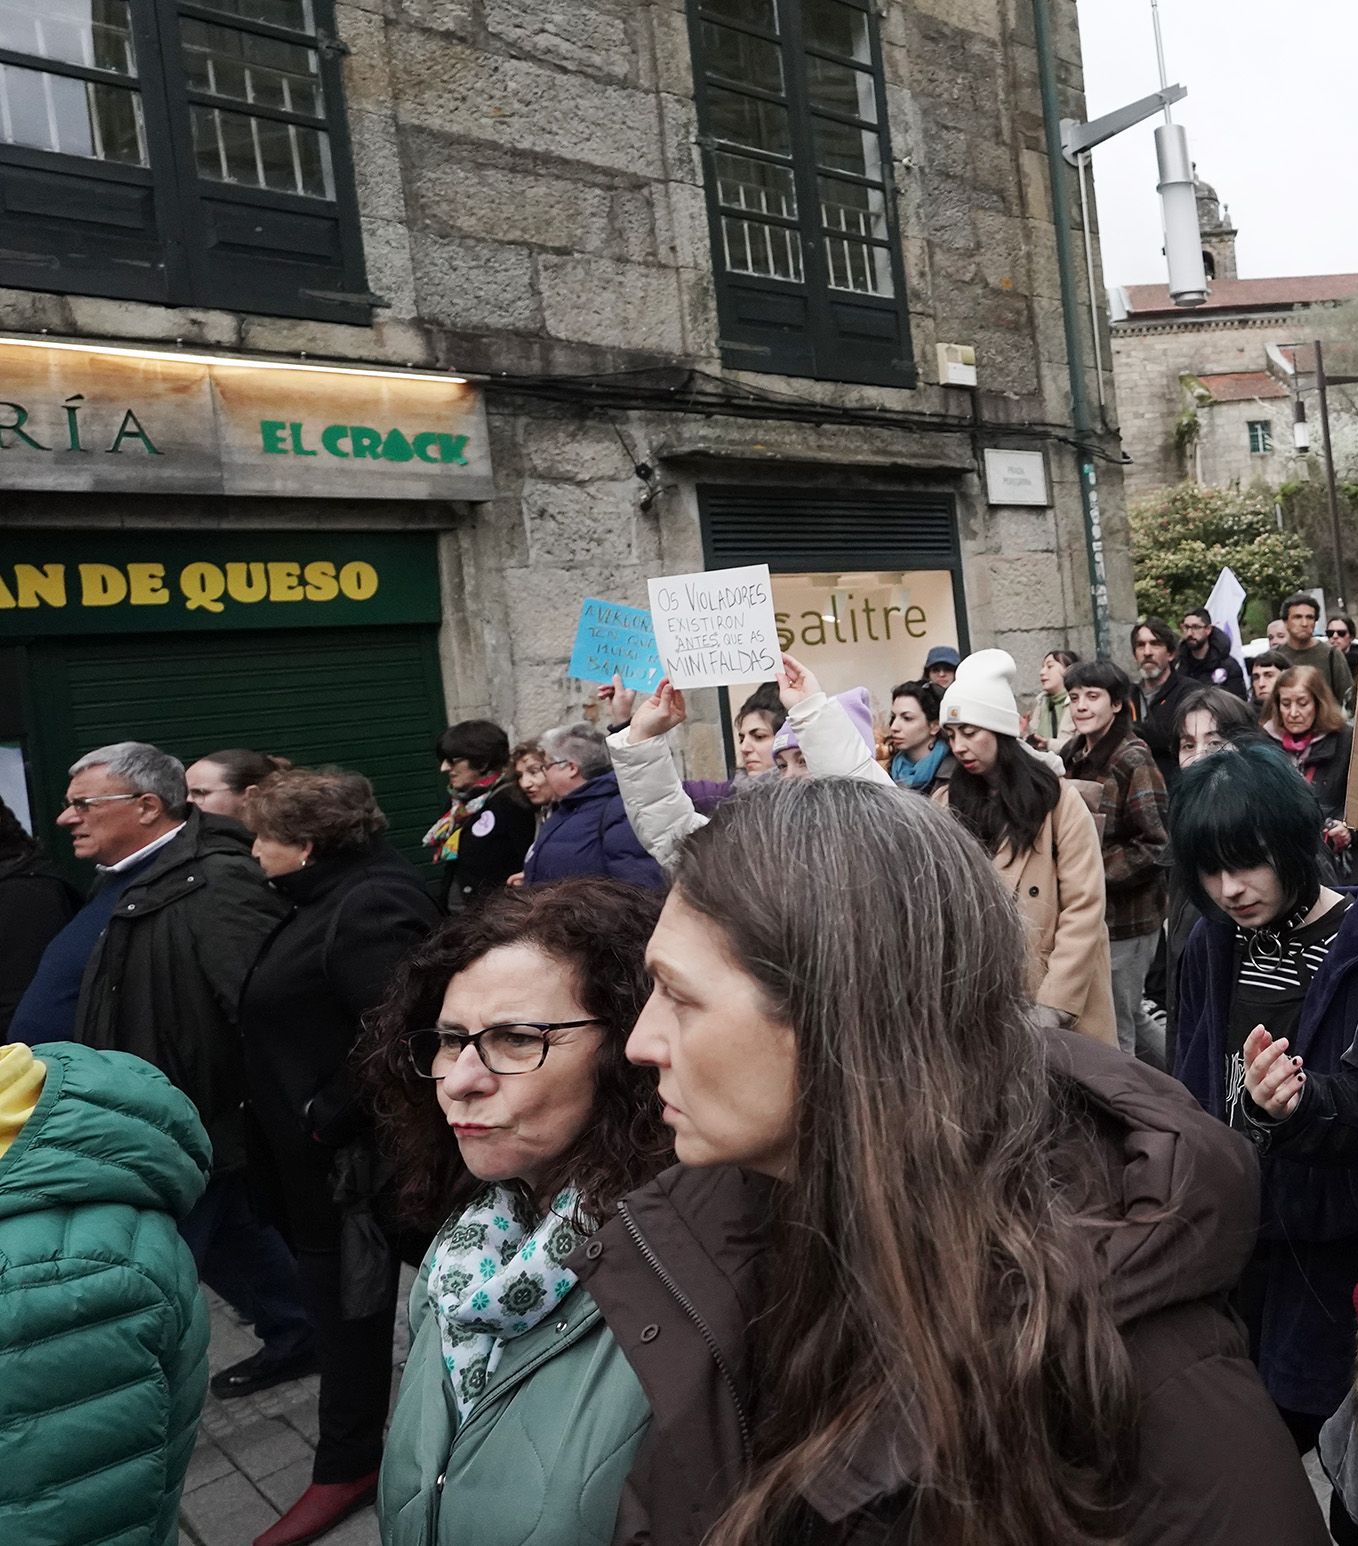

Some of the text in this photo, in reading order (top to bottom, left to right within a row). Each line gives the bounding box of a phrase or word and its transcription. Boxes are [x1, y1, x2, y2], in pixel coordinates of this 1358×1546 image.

[260, 420, 317, 456] EL
[78, 562, 170, 607] DE
[180, 560, 380, 613] QUESO
[685, 582, 767, 612] VIOLADORES
[668, 612, 745, 633] EXISTIRON
[723, 633, 743, 646] QUE
[750, 629, 766, 643] AS
[775, 594, 928, 652] salitre
